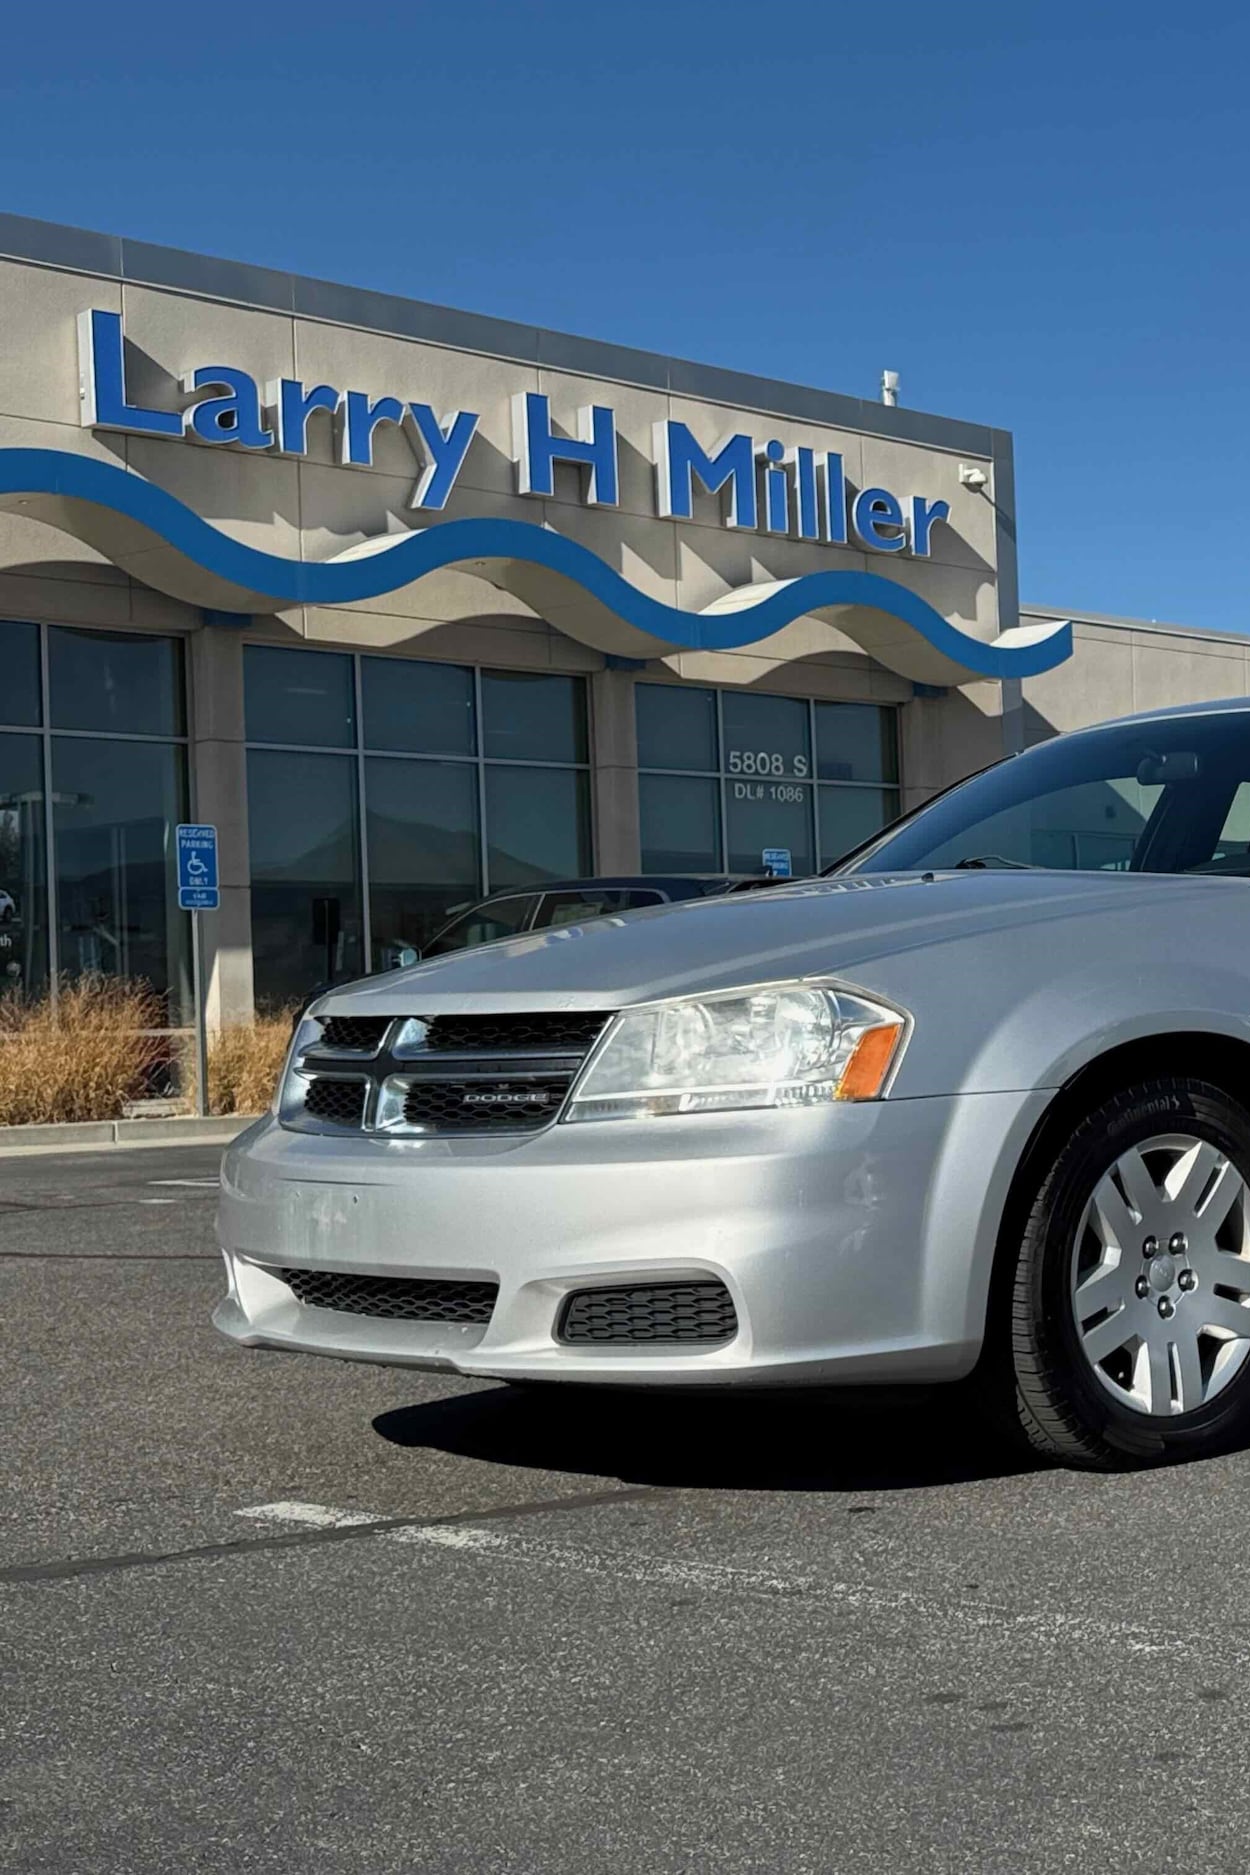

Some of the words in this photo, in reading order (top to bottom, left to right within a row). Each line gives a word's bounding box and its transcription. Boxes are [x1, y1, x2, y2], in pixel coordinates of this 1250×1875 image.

[78, 308, 480, 511] Larry
[511, 390, 619, 507] H
[652, 418, 952, 558] Miller
[729, 751, 784, 776] 5808
[793, 755, 808, 777] S
[734, 783, 765, 800] DL#
[769, 785, 804, 802] 1086
[181, 839, 214, 849] PARKING
[463, 1092, 550, 1104] DODGE
[1108, 1096, 1170, 1136] Continental
